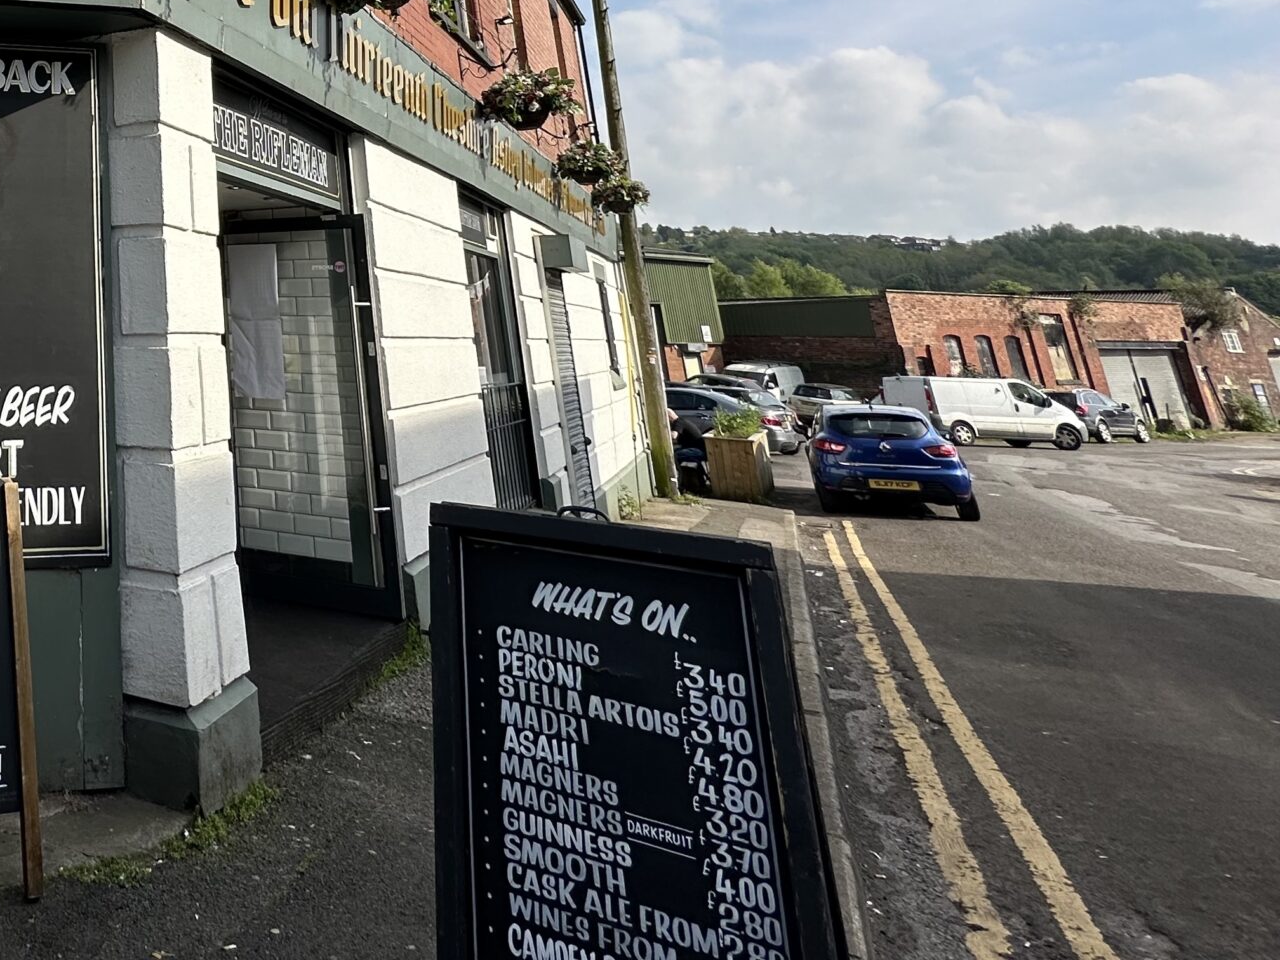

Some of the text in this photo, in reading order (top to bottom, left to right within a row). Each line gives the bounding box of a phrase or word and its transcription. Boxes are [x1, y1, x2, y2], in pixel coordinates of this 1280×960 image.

[213, 103, 329, 188] THE RIFLEMAN
[0, 385, 75, 428] BEER
[532, 582, 632, 626] WHAT'S
[496, 625, 746, 697] CARLING £3.40
[498, 648, 748, 726] PERONI £5.00
[498, 674, 583, 716] STELLA
[588, 695, 680, 738] ARTOIS
[500, 698, 758, 787] MADRI £4.20
[500, 752, 768, 850] MAGNERS £3.20
[503, 726, 764, 818] ASAHI £4.80
[501, 778, 771, 880] MAGNERS DARKFRUIT £3.70
[502, 807, 776, 914] GUINNESS £4.00
[504, 834, 783, 946] SMOOTH £2.80
[506, 862, 577, 909] CASK
[584, 888, 634, 928] ALE
[639, 904, 719, 960] FROM
[508, 892, 678, 960] WINES FROM
